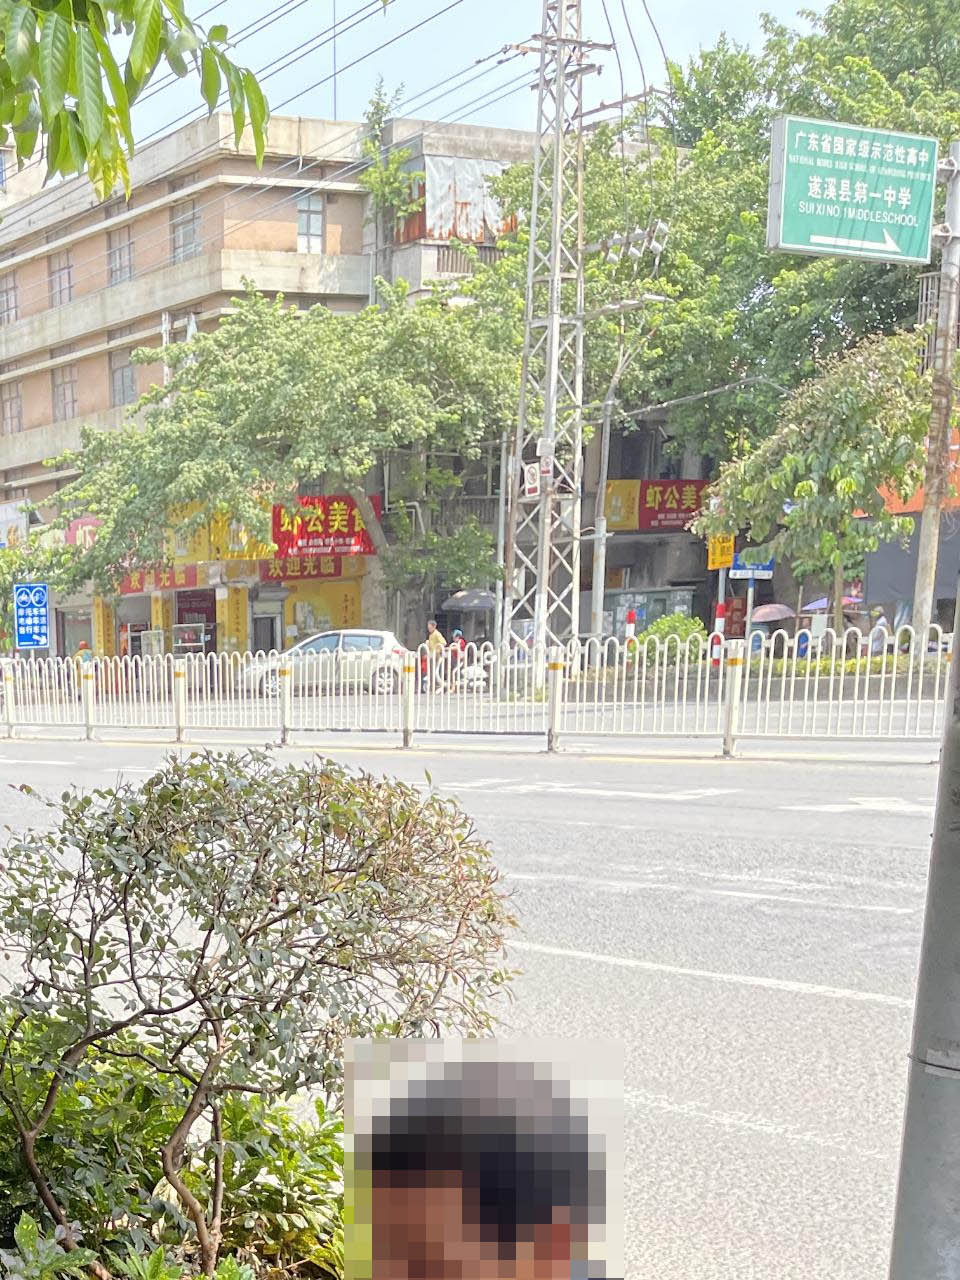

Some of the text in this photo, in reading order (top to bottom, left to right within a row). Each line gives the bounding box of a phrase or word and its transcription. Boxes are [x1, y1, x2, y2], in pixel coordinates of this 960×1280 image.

[808, 175, 912, 210] 遂溪县第一中学
